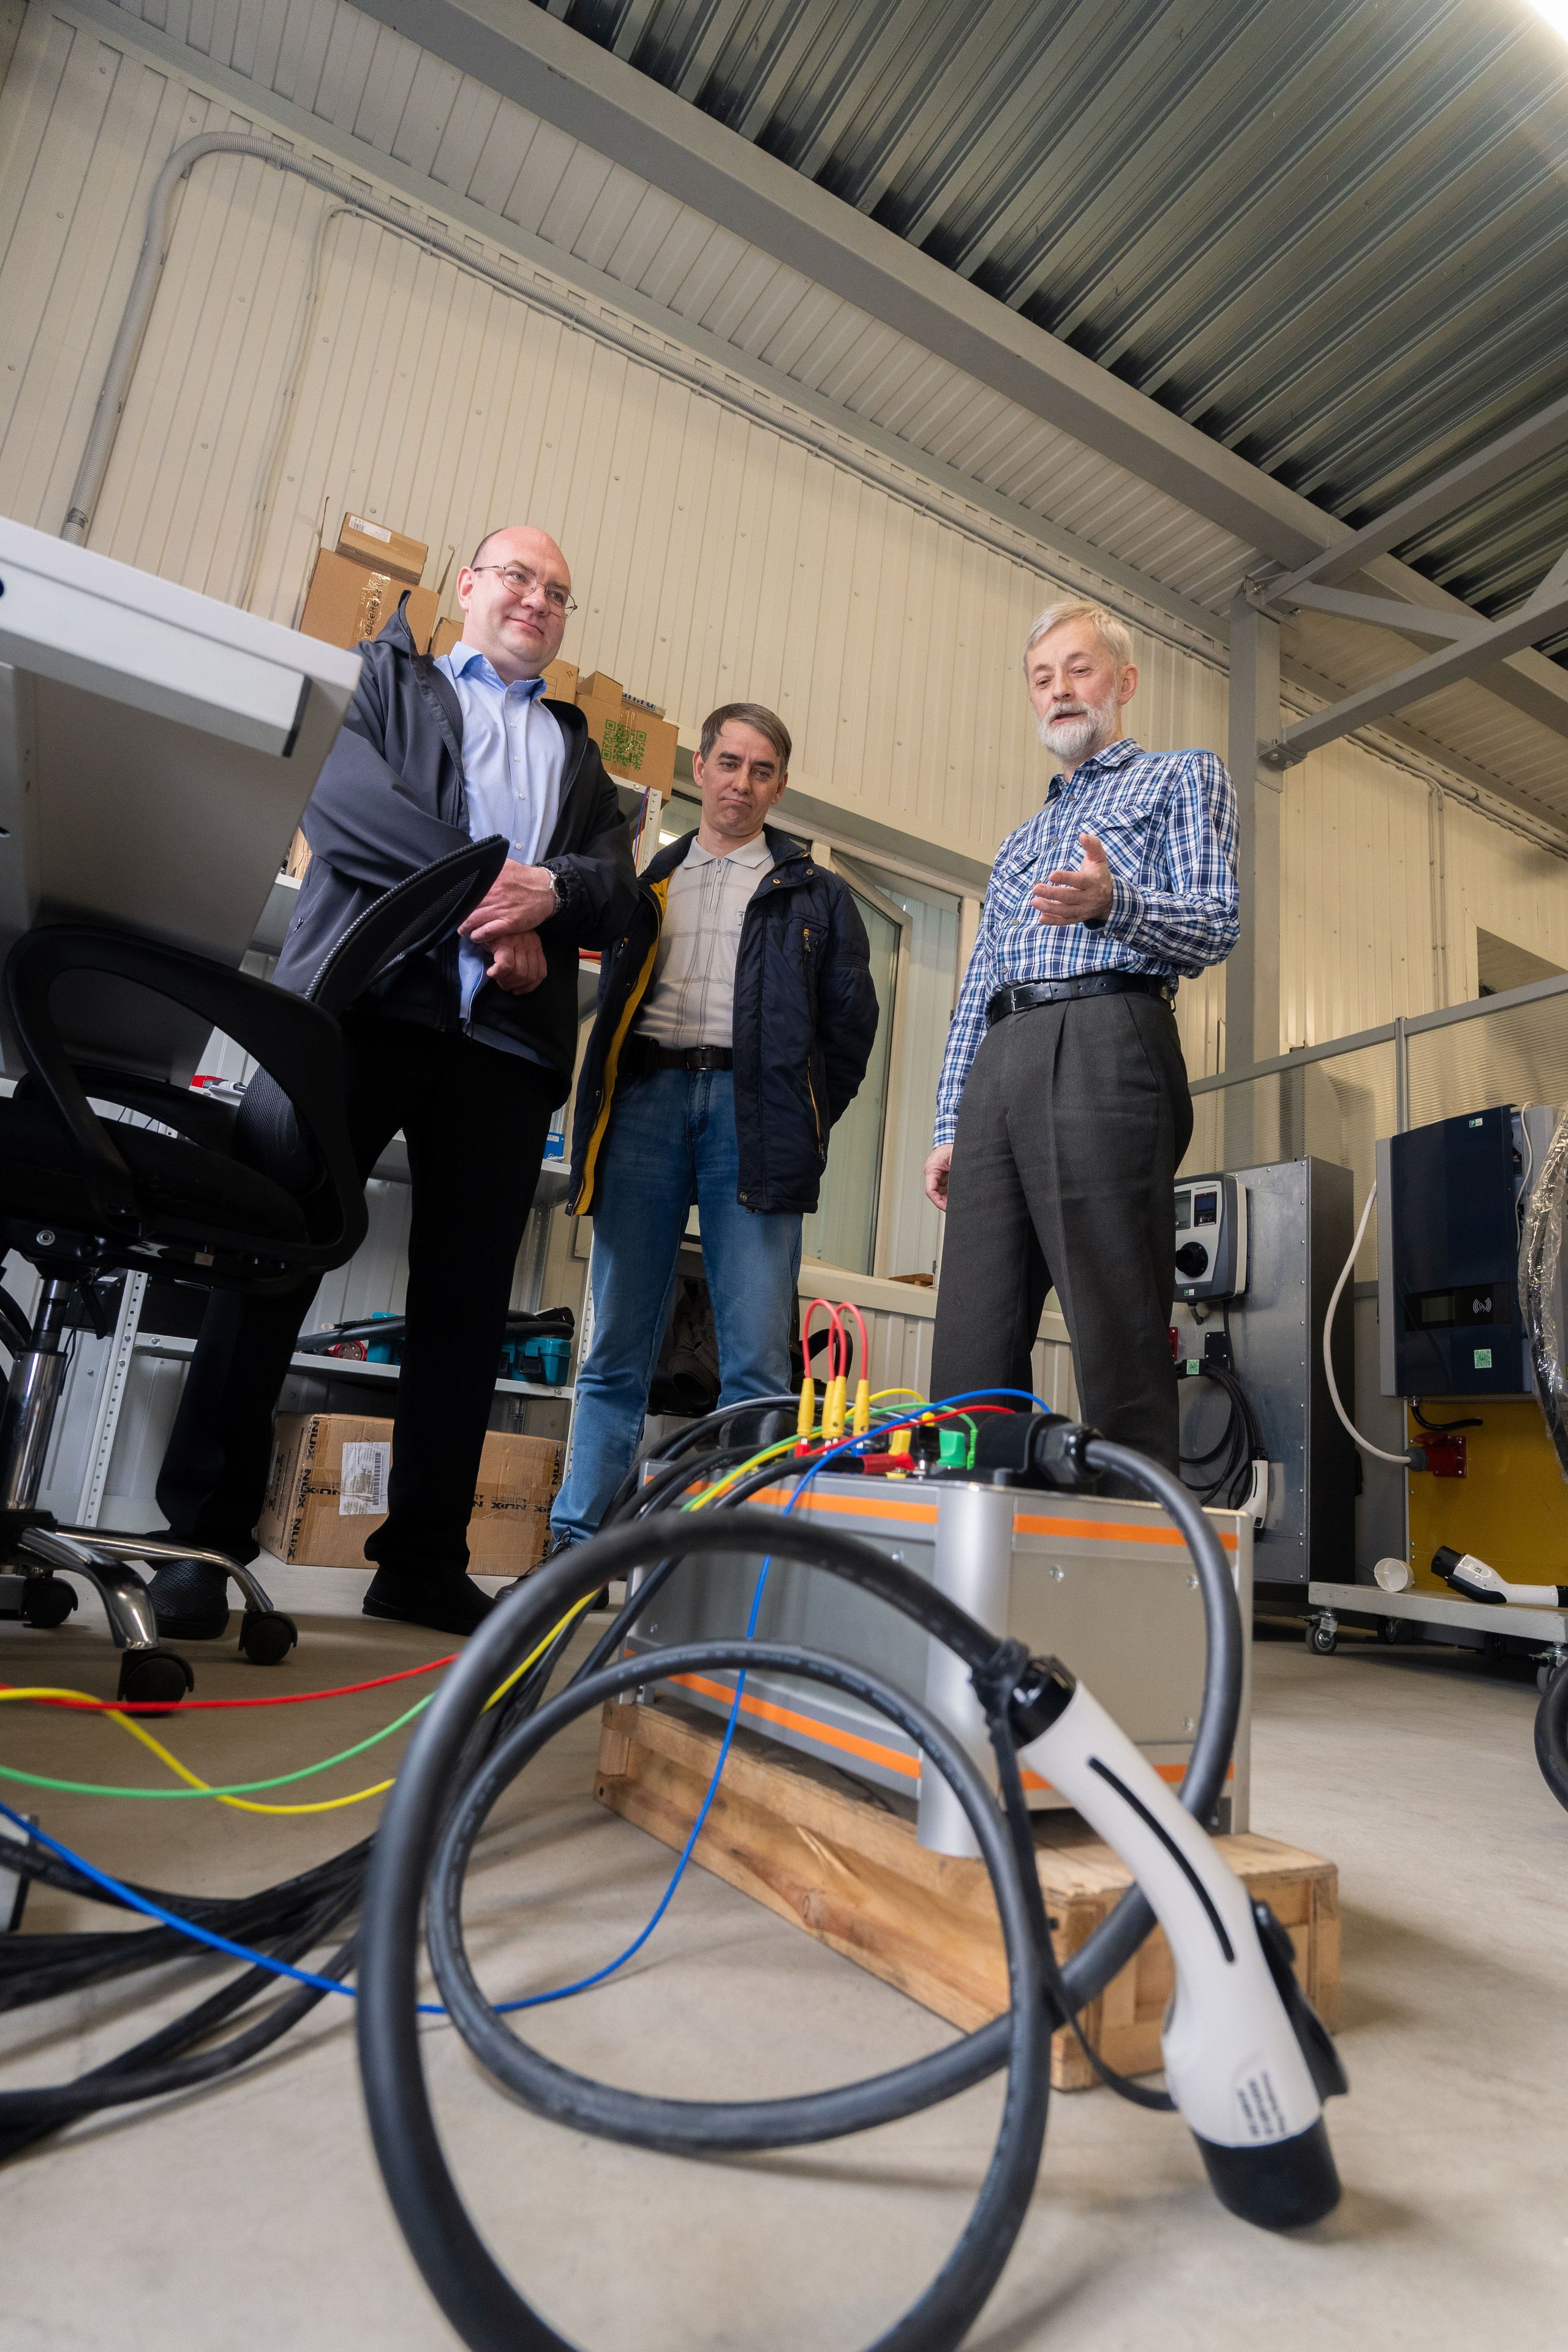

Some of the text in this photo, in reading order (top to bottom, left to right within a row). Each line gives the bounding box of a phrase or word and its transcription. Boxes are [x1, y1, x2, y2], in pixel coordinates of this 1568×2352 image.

[306, 1421, 319, 1460] NUX
[298, 1469, 311, 1509] NUX
[491, 1502, 527, 1510] NUX
[287, 1518, 302, 1559] NUX
